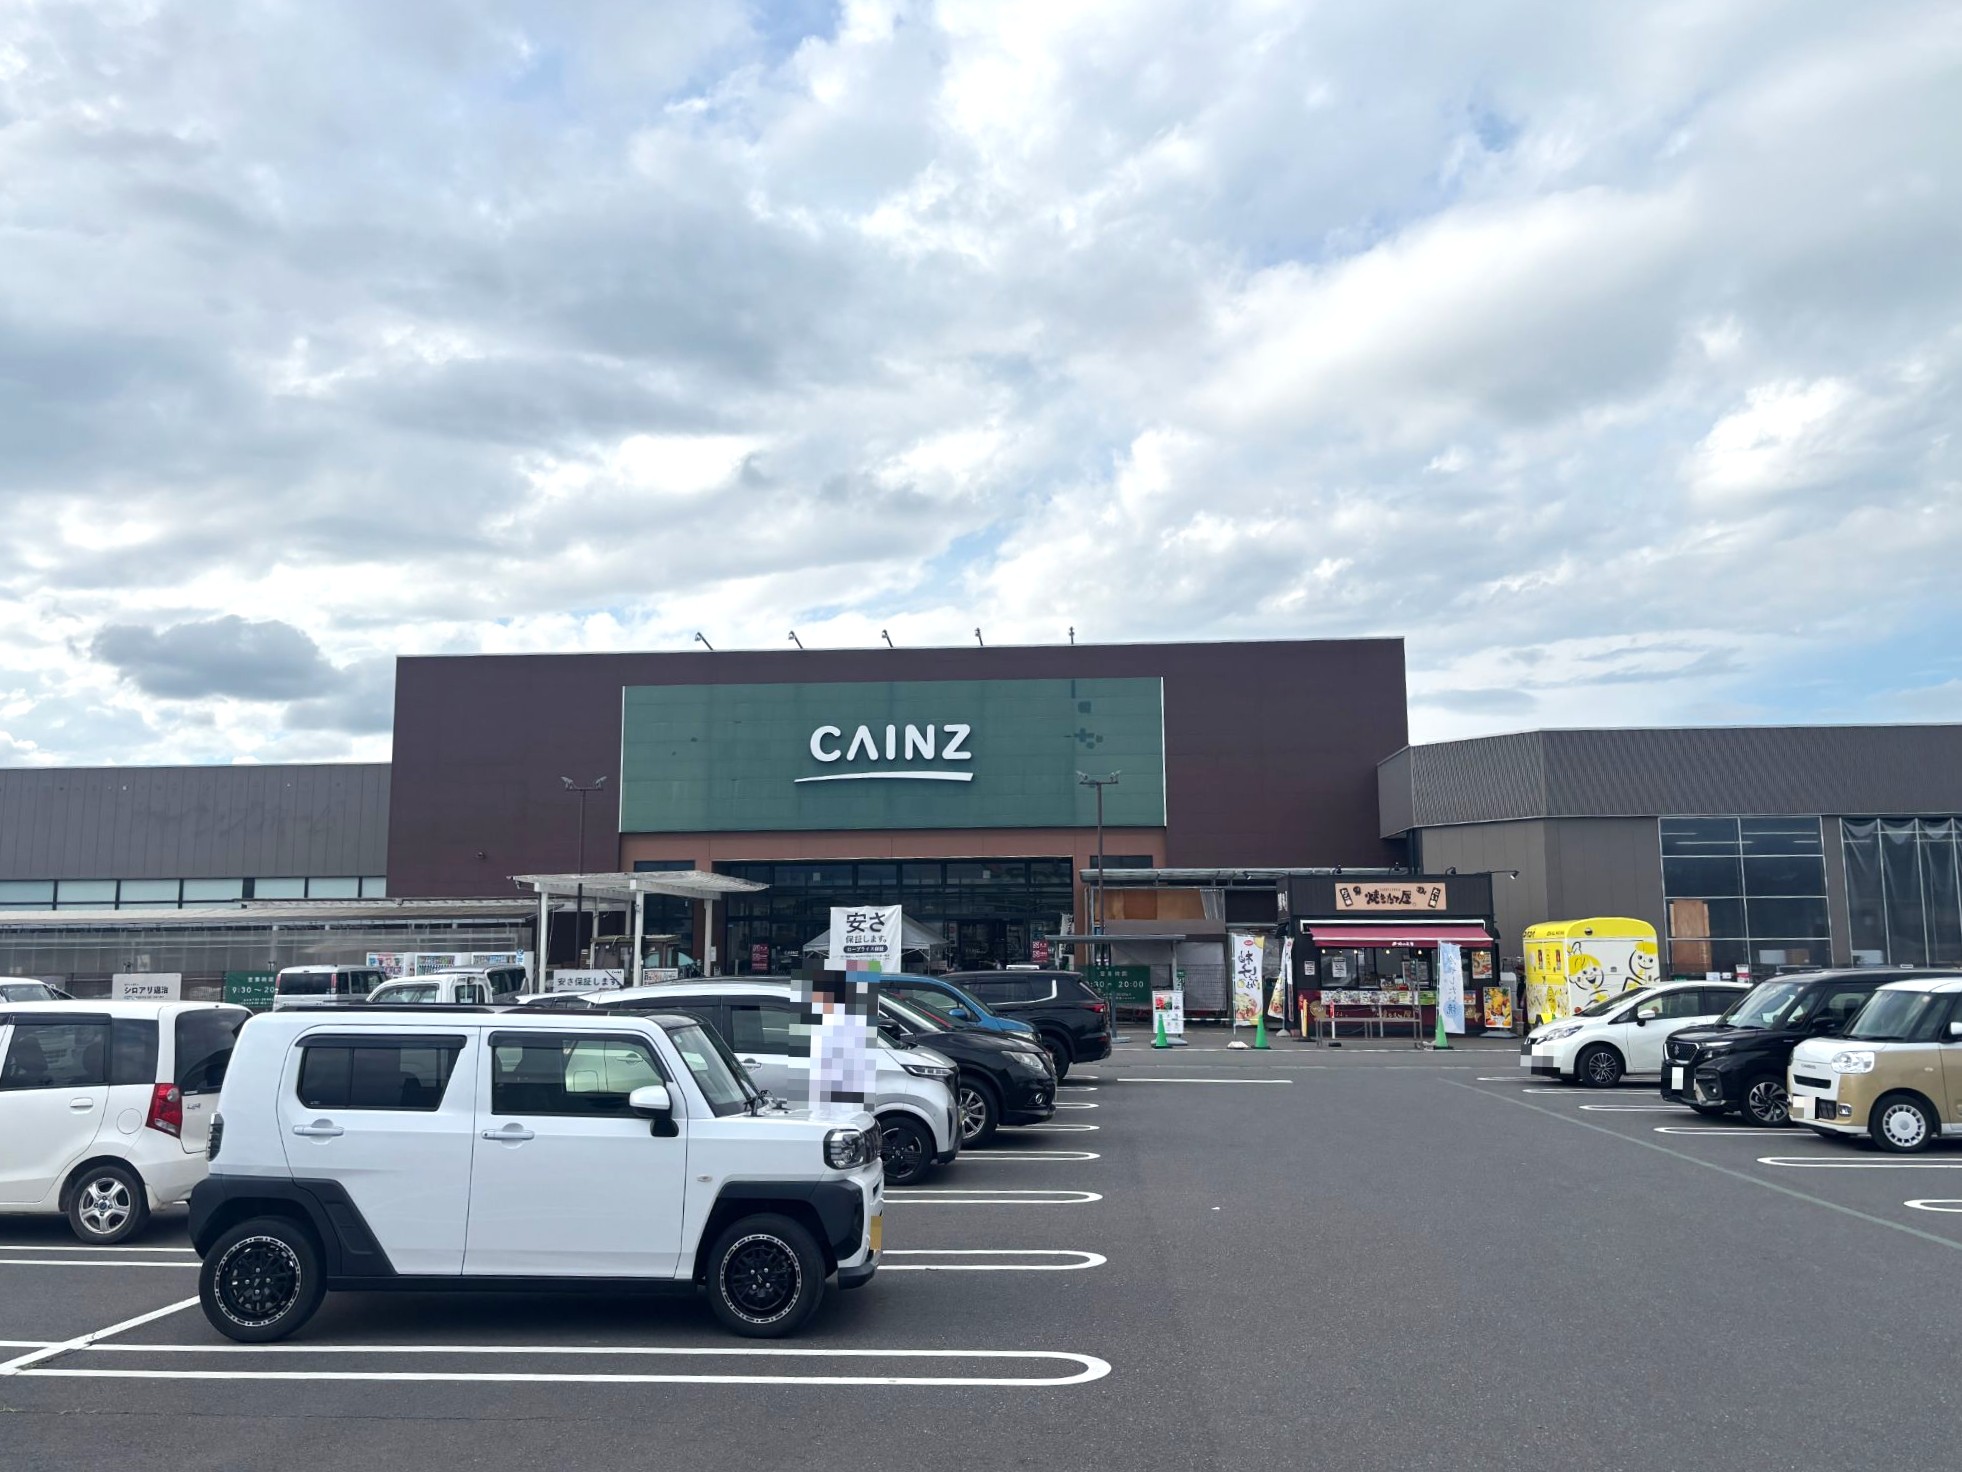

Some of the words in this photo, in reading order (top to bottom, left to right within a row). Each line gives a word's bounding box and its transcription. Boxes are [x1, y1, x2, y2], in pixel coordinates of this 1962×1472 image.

[809, 724, 972, 762] CAINZ
[846, 912, 886, 934] 安さ
[845, 935, 887, 944] 保証します。
[124, 986, 169, 994] シロアリ退治
